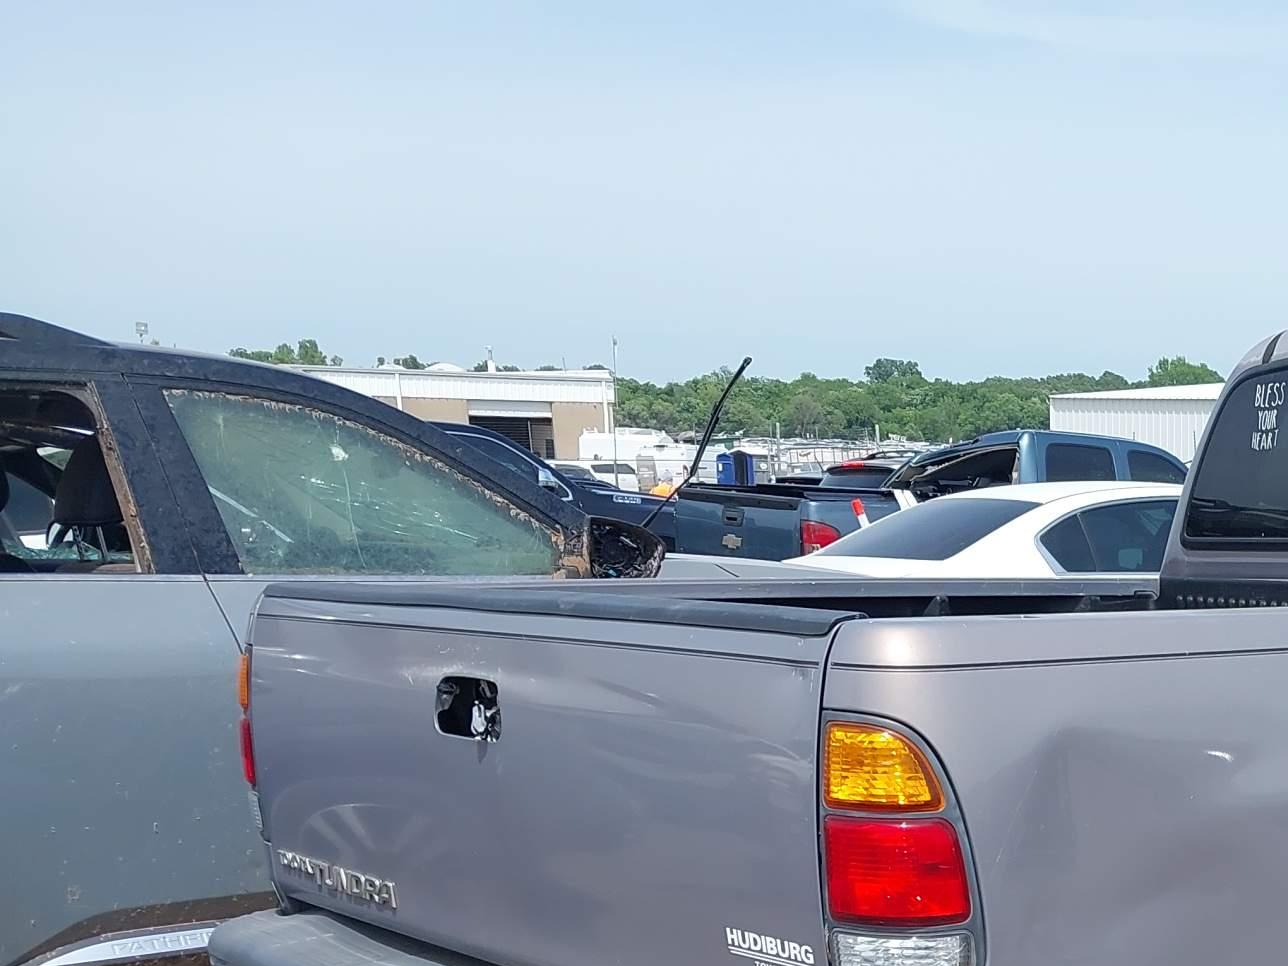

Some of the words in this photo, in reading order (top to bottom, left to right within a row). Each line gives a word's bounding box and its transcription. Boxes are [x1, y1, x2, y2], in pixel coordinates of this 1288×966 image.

[1254, 382, 1287, 408] BLESS
[1258, 409, 1278, 431] YOUR
[1251, 429, 1280, 451] HEART
[309, 858, 397, 909] TUNDRA
[111, 929, 214, 956] PATHFI
[725, 926, 815, 965] HUDIBURG
